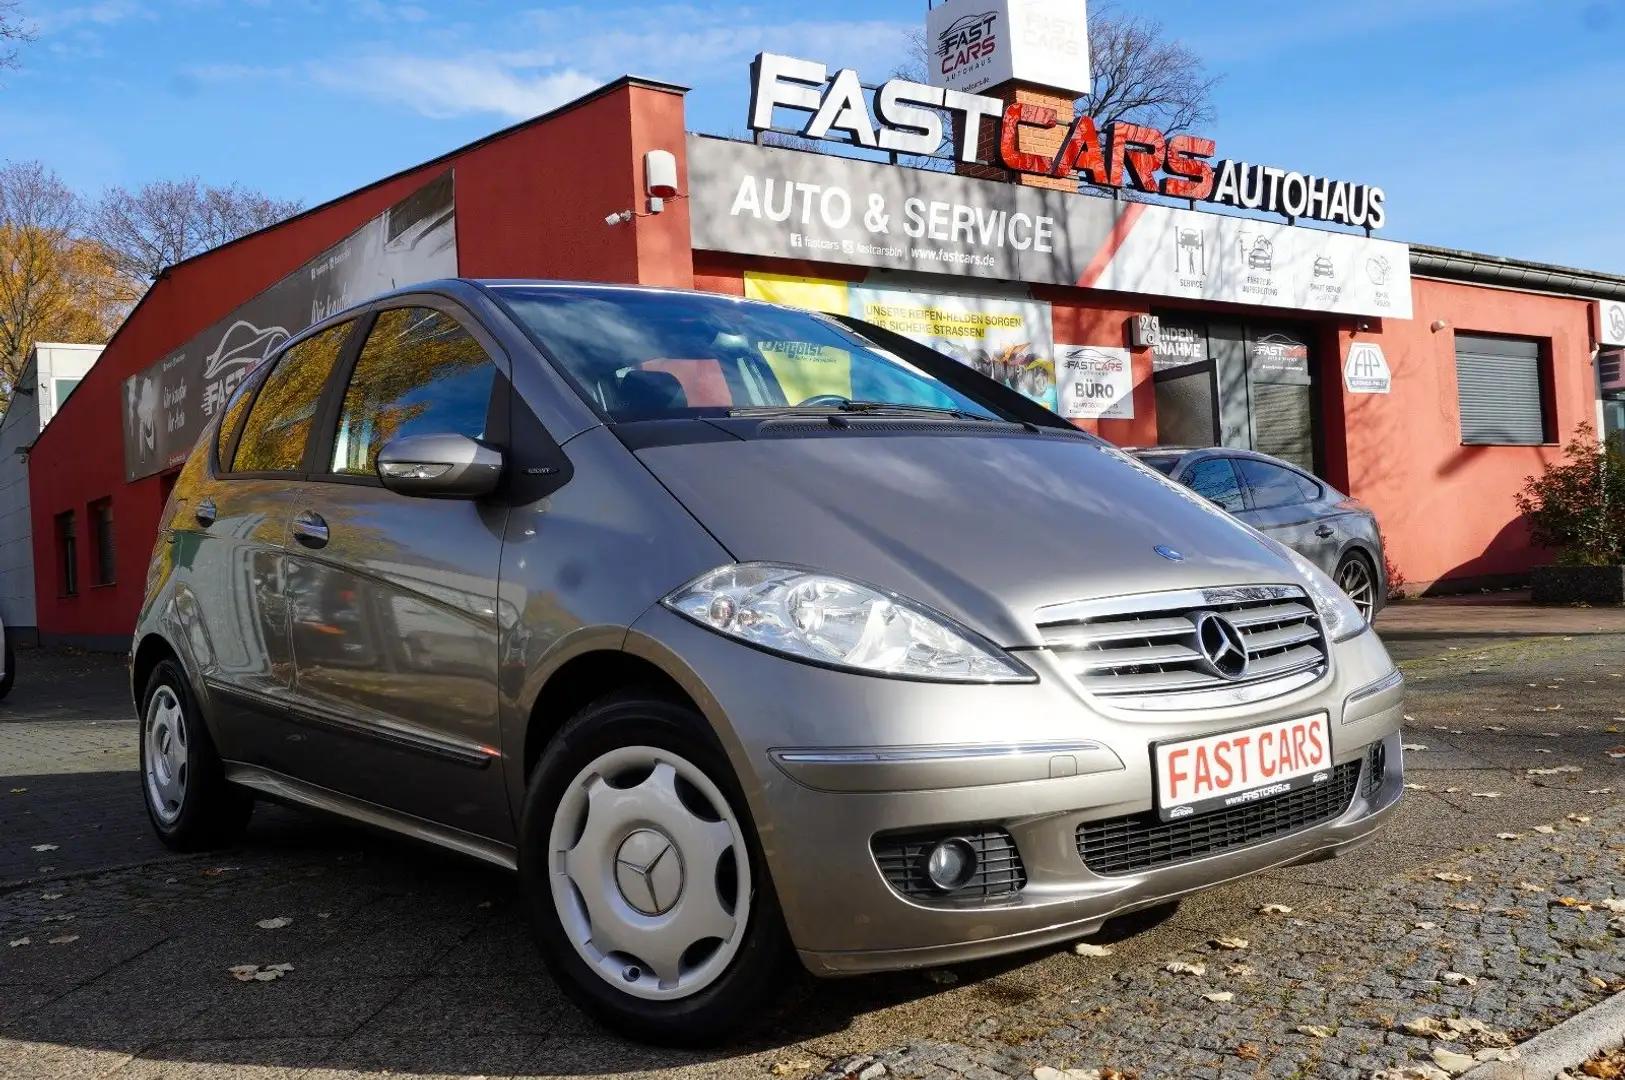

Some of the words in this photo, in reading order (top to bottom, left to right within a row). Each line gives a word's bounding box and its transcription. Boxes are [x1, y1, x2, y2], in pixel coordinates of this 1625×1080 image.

[939, 15, 997, 56] FAST
[942, 35, 996, 75] CARS
[945, 58, 992, 83] AUTOHAUS
[1213, 159, 1386, 229] AUTOHAUS
[730, 175, 852, 229] AUTO
[864, 193, 890, 236] &
[903, 198, 1054, 253] SERVICE
[804, 236, 840, 250] fastcars
[911, 248, 995, 267] www.fastcars.de
[1180, 278, 1203, 289] SERVICE
[866, 305, 906, 318] UNSERE
[908, 308, 983, 325] REIFEN-HELDEN
[985, 315, 1022, 328] SORGEN
[889, 319, 932, 334] SICHERE
[933, 325, 985, 338] STRASSEN!
[1140, 315, 1158, 332] 26
[1159, 326, 1198, 342] NDEN-
[1075, 378, 1114, 399] BÜRO
[1168, 736, 1251, 799] FAST
[1258, 720, 1323, 778] CARS
